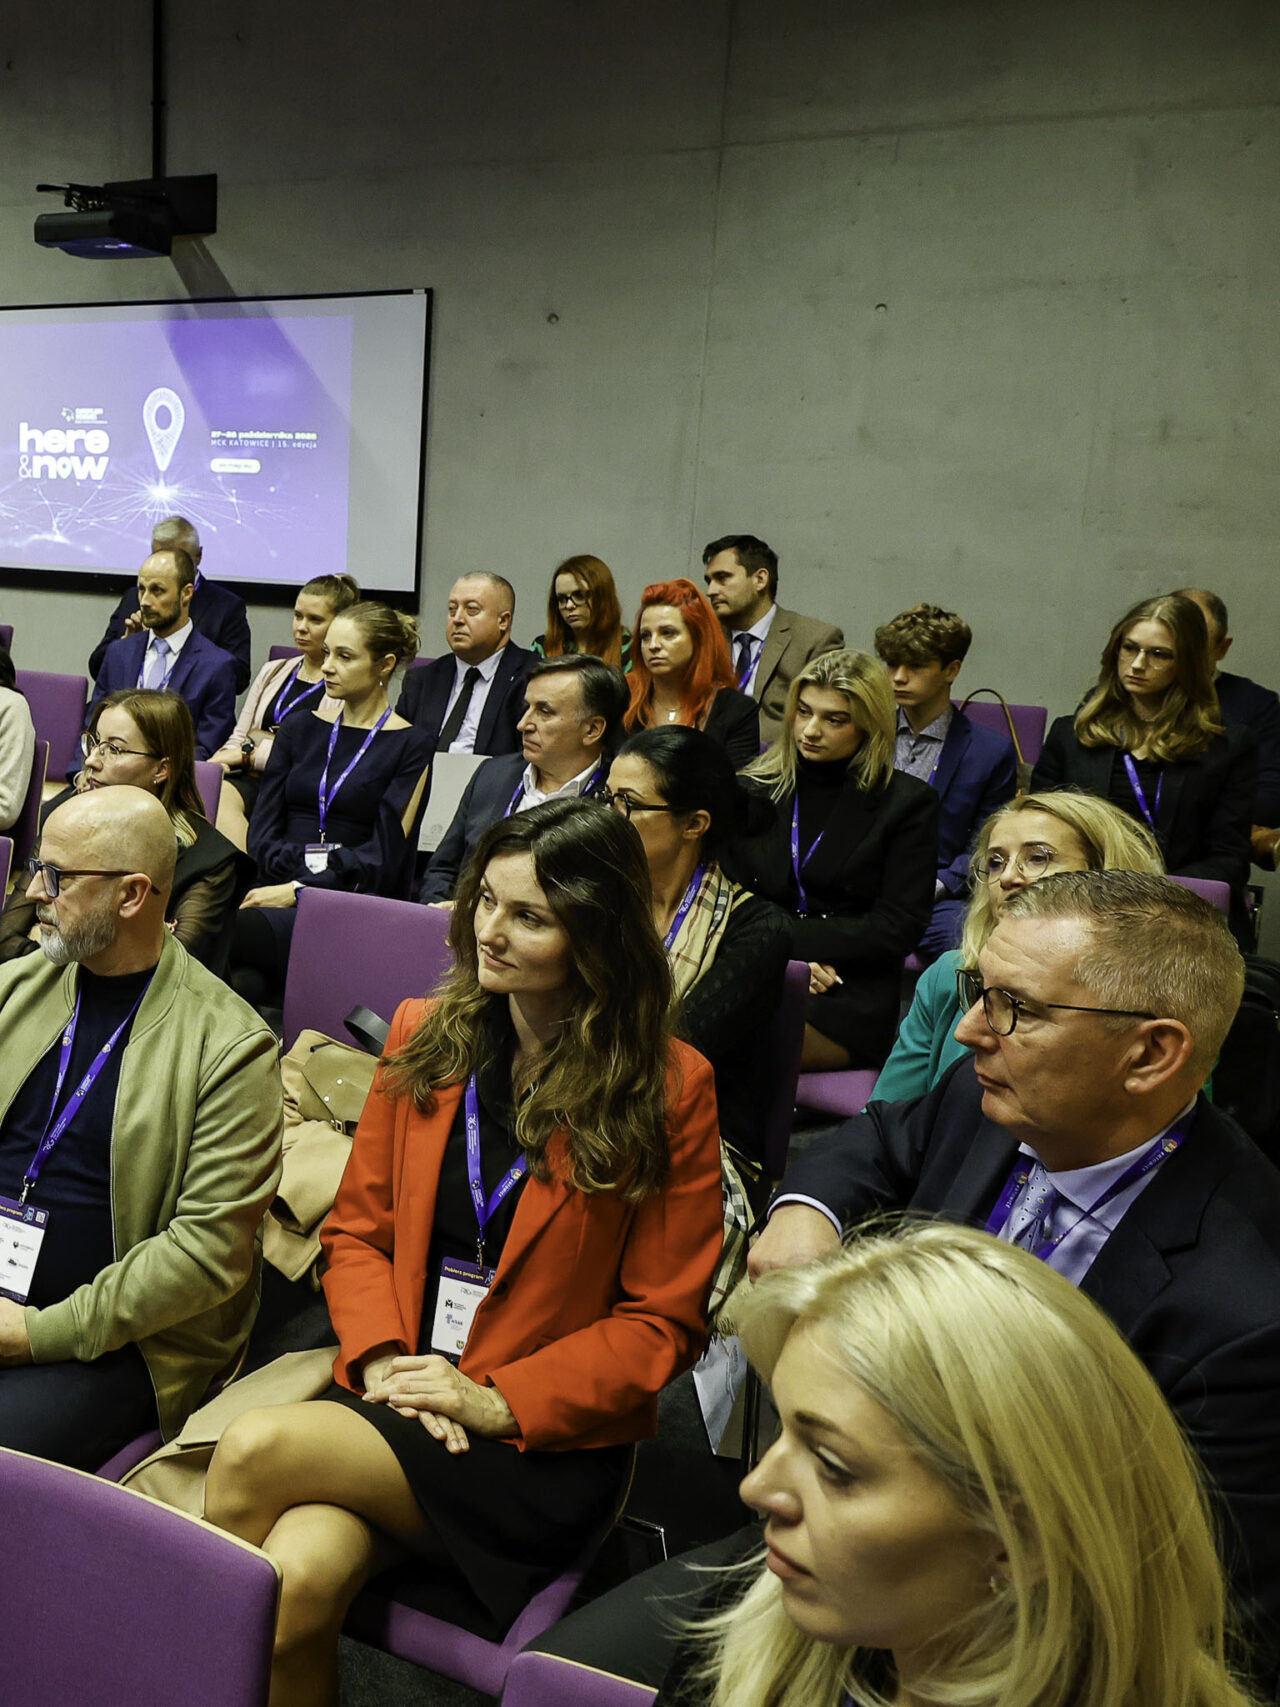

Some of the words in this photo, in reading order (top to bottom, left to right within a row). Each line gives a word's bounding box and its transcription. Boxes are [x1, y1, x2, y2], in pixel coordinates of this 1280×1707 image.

[19, 422, 110, 454] here
[210, 439, 227, 447] MCK
[229, 440, 269, 448] KATOWICE
[292, 441, 317, 450] edycja
